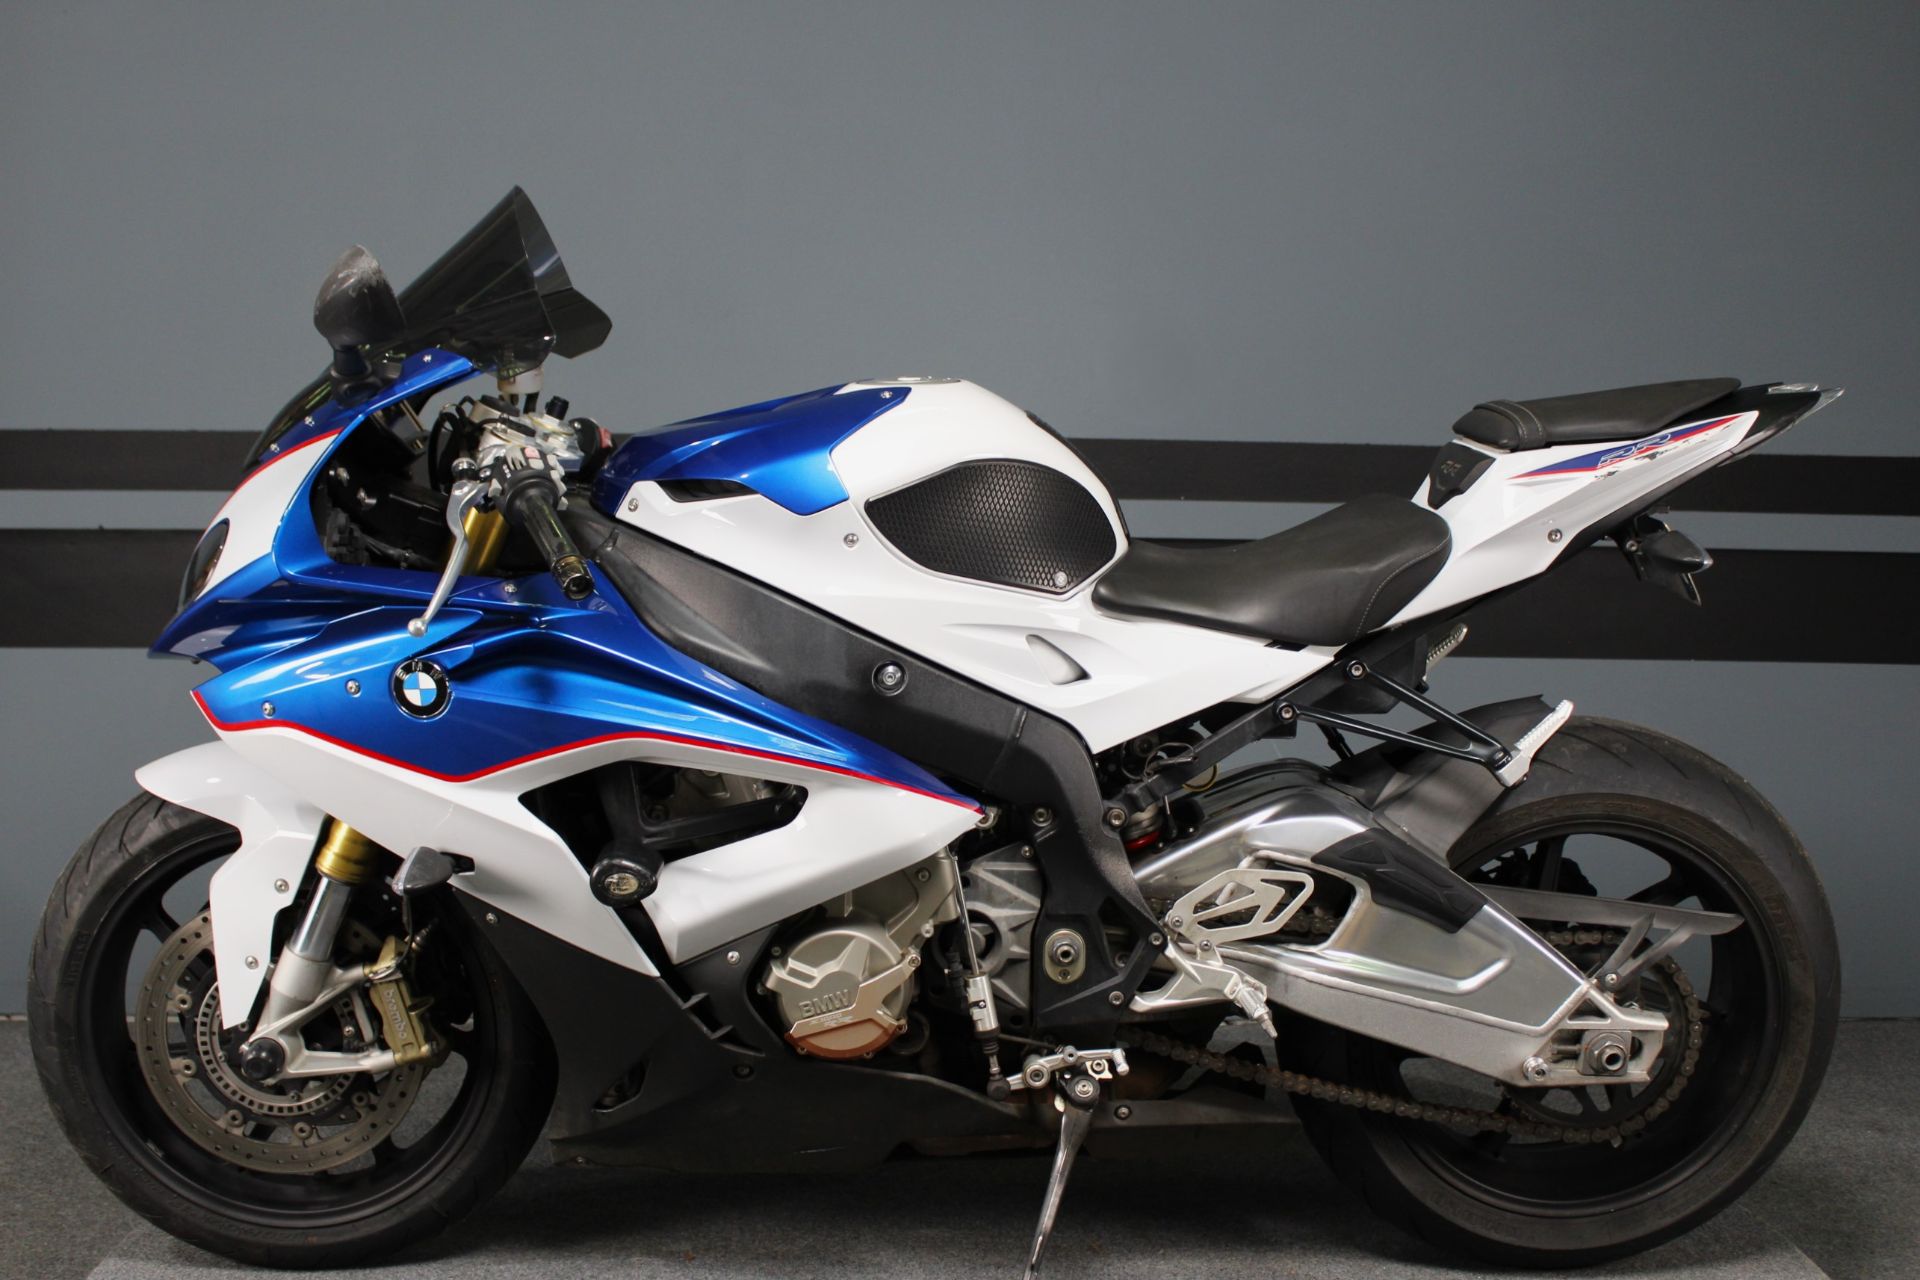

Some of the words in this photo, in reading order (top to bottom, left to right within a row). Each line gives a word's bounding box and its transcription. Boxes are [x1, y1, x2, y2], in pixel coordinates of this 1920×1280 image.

[396, 661, 443, 680] BMW
[384, 988, 407, 1039] brembo
[798, 989, 850, 1019] BMW
